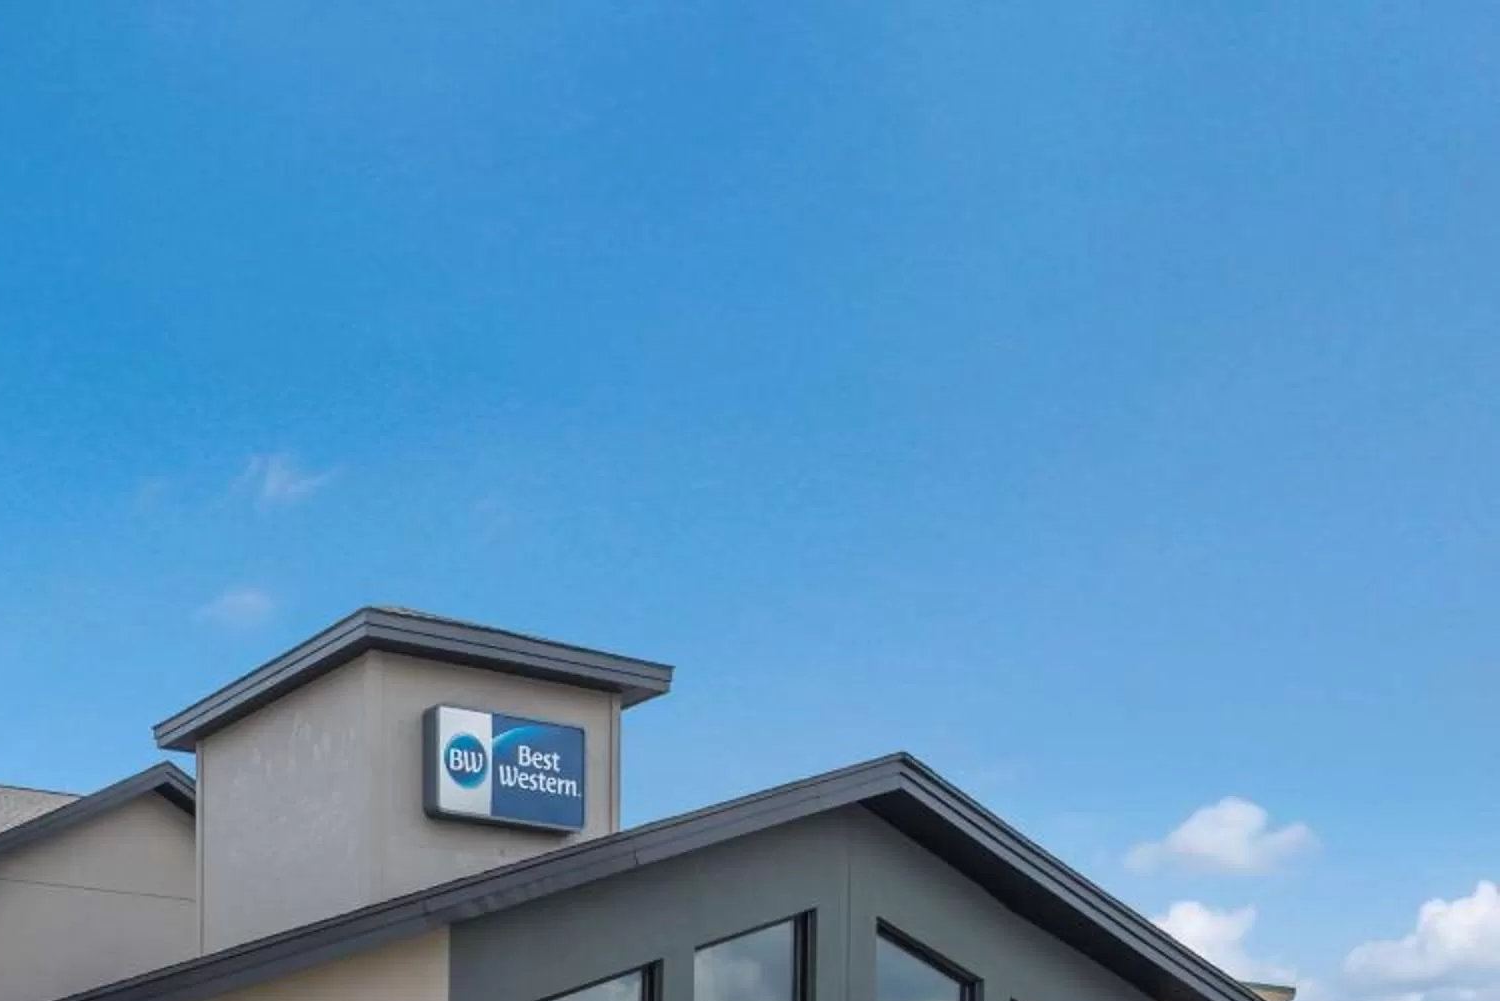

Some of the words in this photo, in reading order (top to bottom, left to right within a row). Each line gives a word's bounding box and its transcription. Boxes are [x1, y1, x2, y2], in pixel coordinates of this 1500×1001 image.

[450, 748, 483, 773] BW
[518, 745, 561, 772] Best
[499, 764, 579, 797] Western
